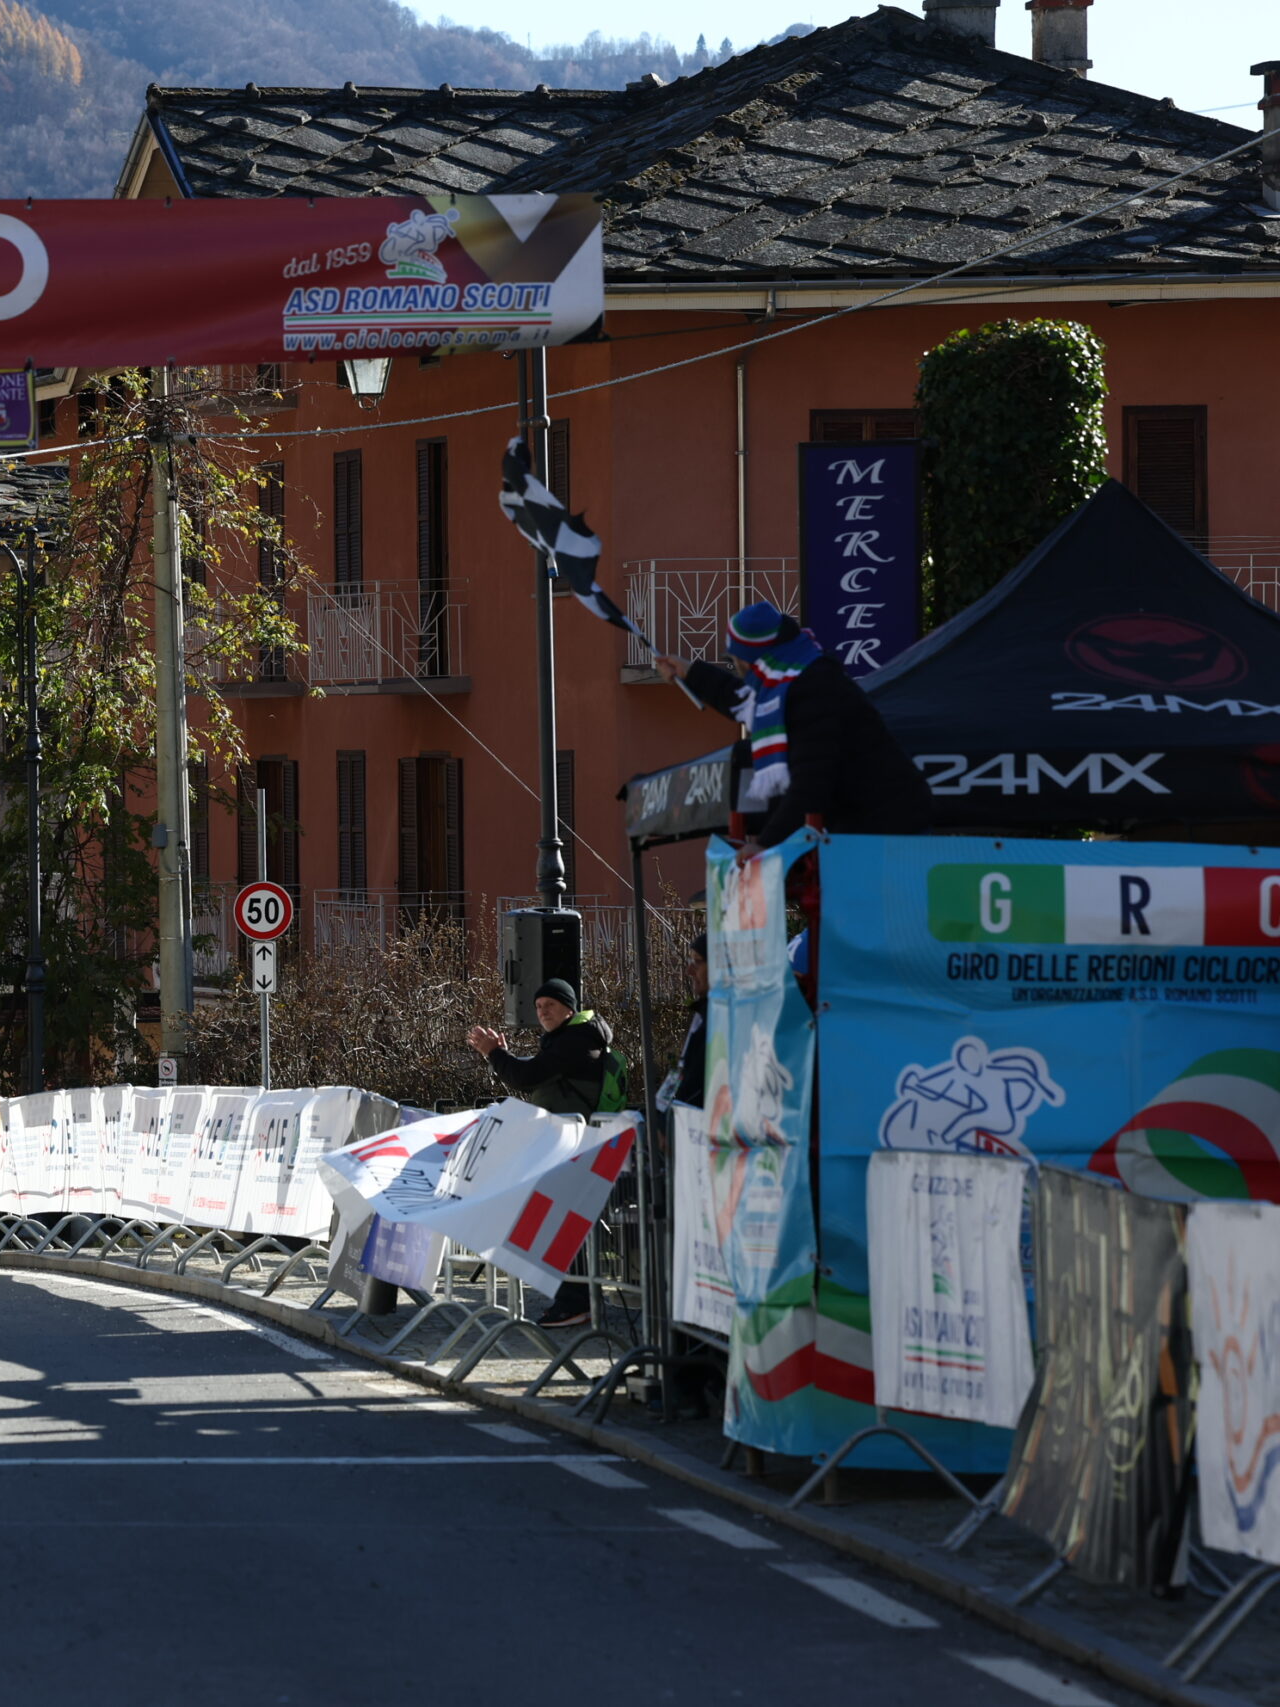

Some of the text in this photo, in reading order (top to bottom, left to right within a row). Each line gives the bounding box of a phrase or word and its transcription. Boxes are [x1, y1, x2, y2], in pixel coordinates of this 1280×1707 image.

[283, 242, 373, 279] dal 1959
[283, 283, 551, 315] ASD ROMANO SCOTTI
[284, 327, 550, 351] www.ciclocrossroma.it
[828, 458, 895, 680] MERCER
[1051, 692, 1280, 716] 24MX
[913, 753, 1172, 795] 24MX
[247, 898, 279, 924] 50
[980, 872, 1012, 934] G
[1120, 875, 1151, 936] R
[947, 952, 999, 981] GIRO
[1008, 953, 1079, 982] DELLE
[1087, 954, 1175, 983] REGIONI
